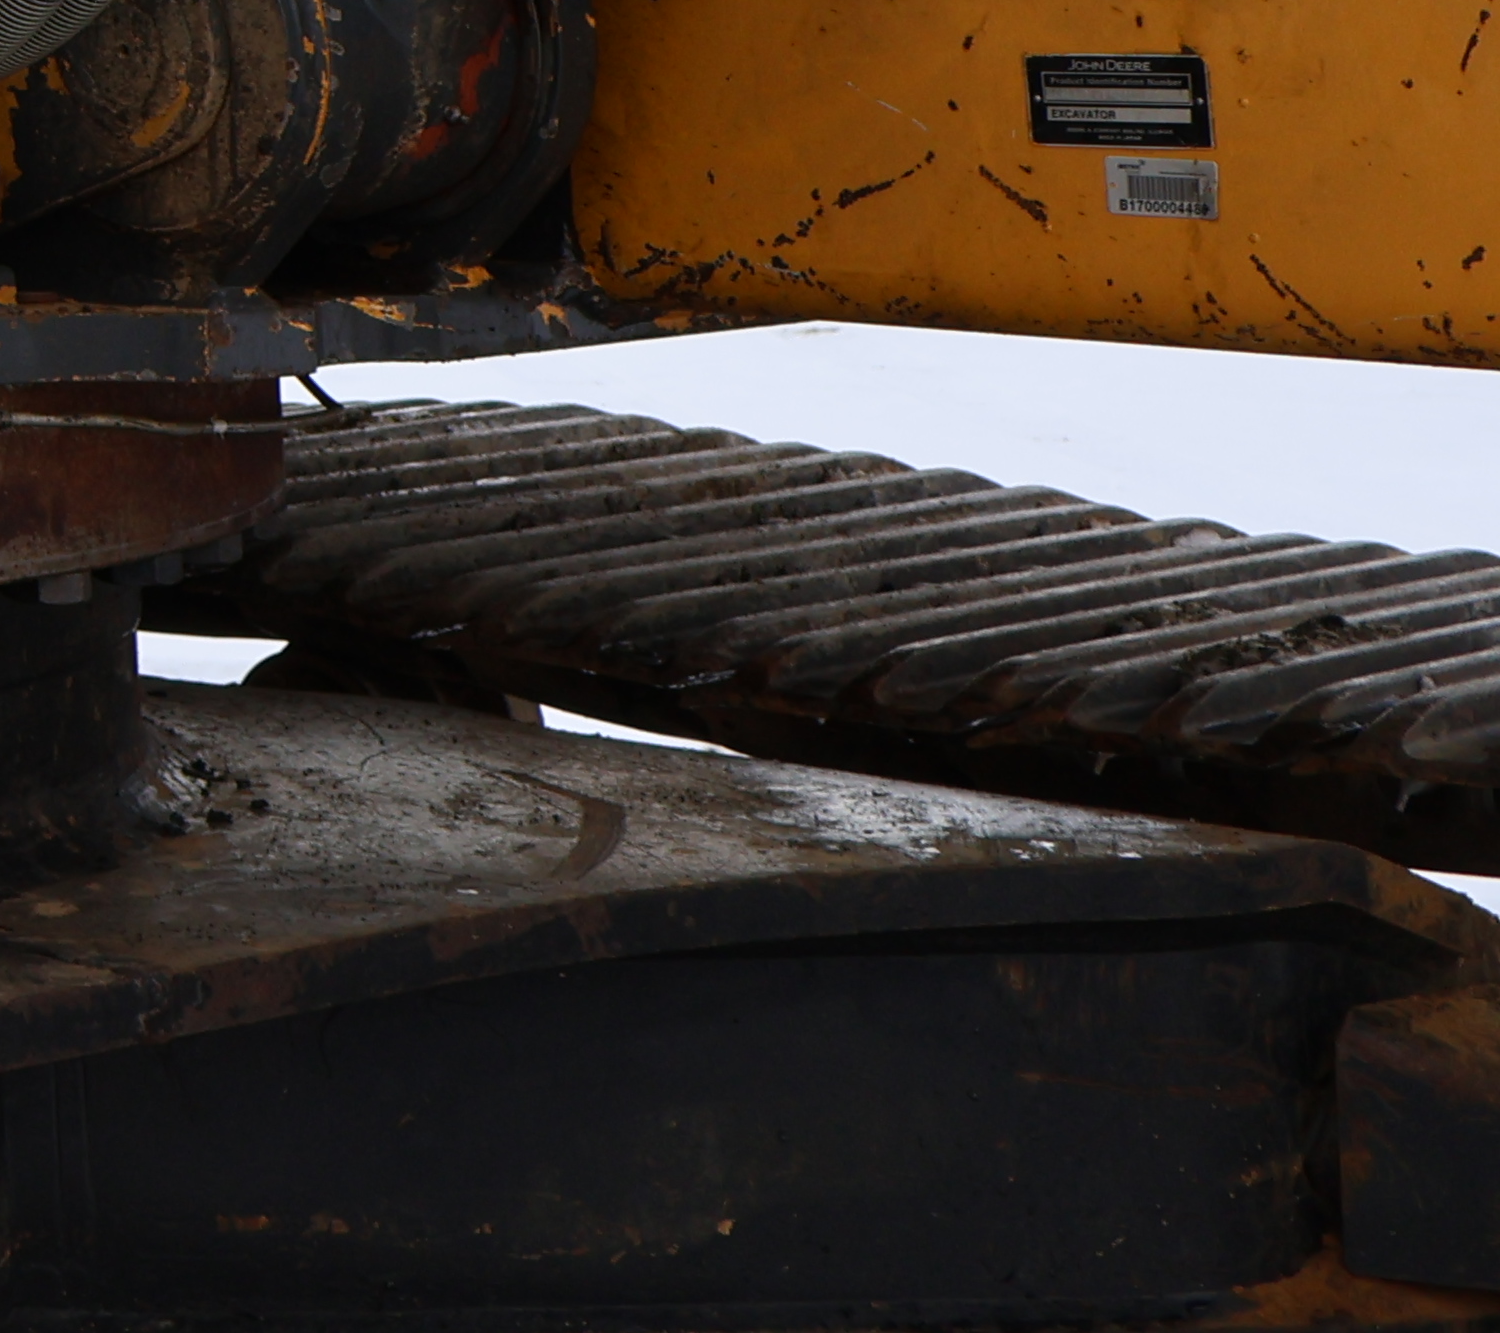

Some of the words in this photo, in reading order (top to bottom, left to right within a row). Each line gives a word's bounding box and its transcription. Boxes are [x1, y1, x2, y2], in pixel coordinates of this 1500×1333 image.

[1067, 58, 1104, 71] JOHN
[1106, 59, 1151, 71] DEERE
[1051, 109, 1116, 120] EXCAVATOR
[1119, 198, 1210, 216] B170000448
